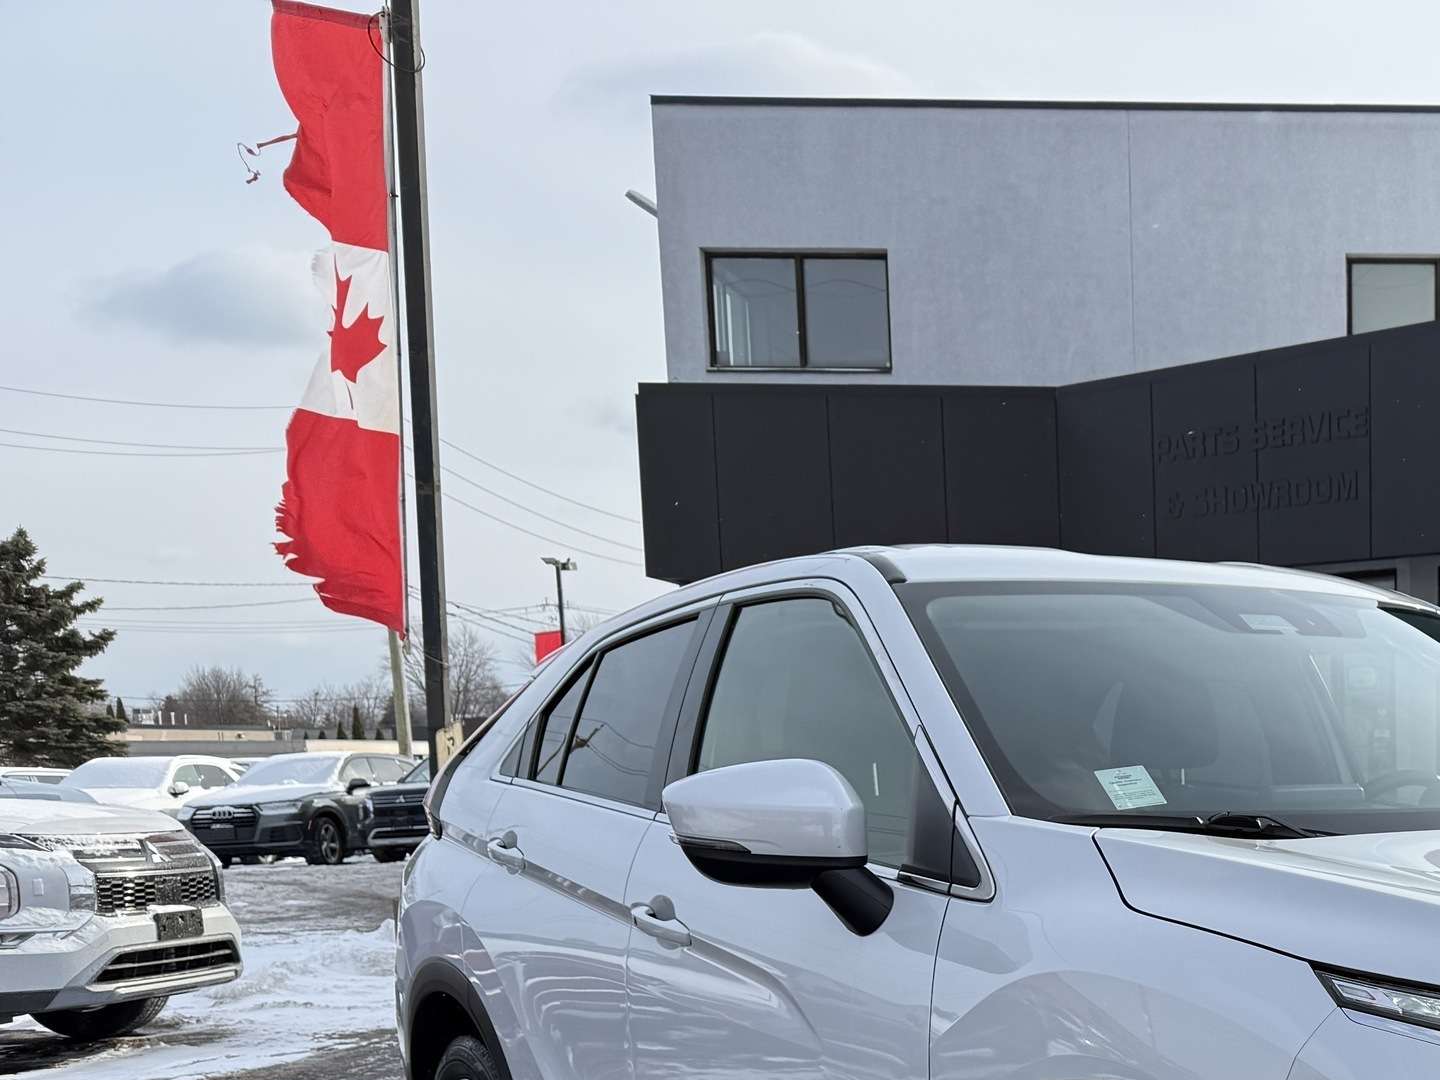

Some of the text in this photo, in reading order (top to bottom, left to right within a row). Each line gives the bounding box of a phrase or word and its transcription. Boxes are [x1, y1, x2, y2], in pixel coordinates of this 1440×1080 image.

[1156, 406, 1370, 464] PARTS SERVICE
[1193, 469, 1360, 518] SHOWROOM
